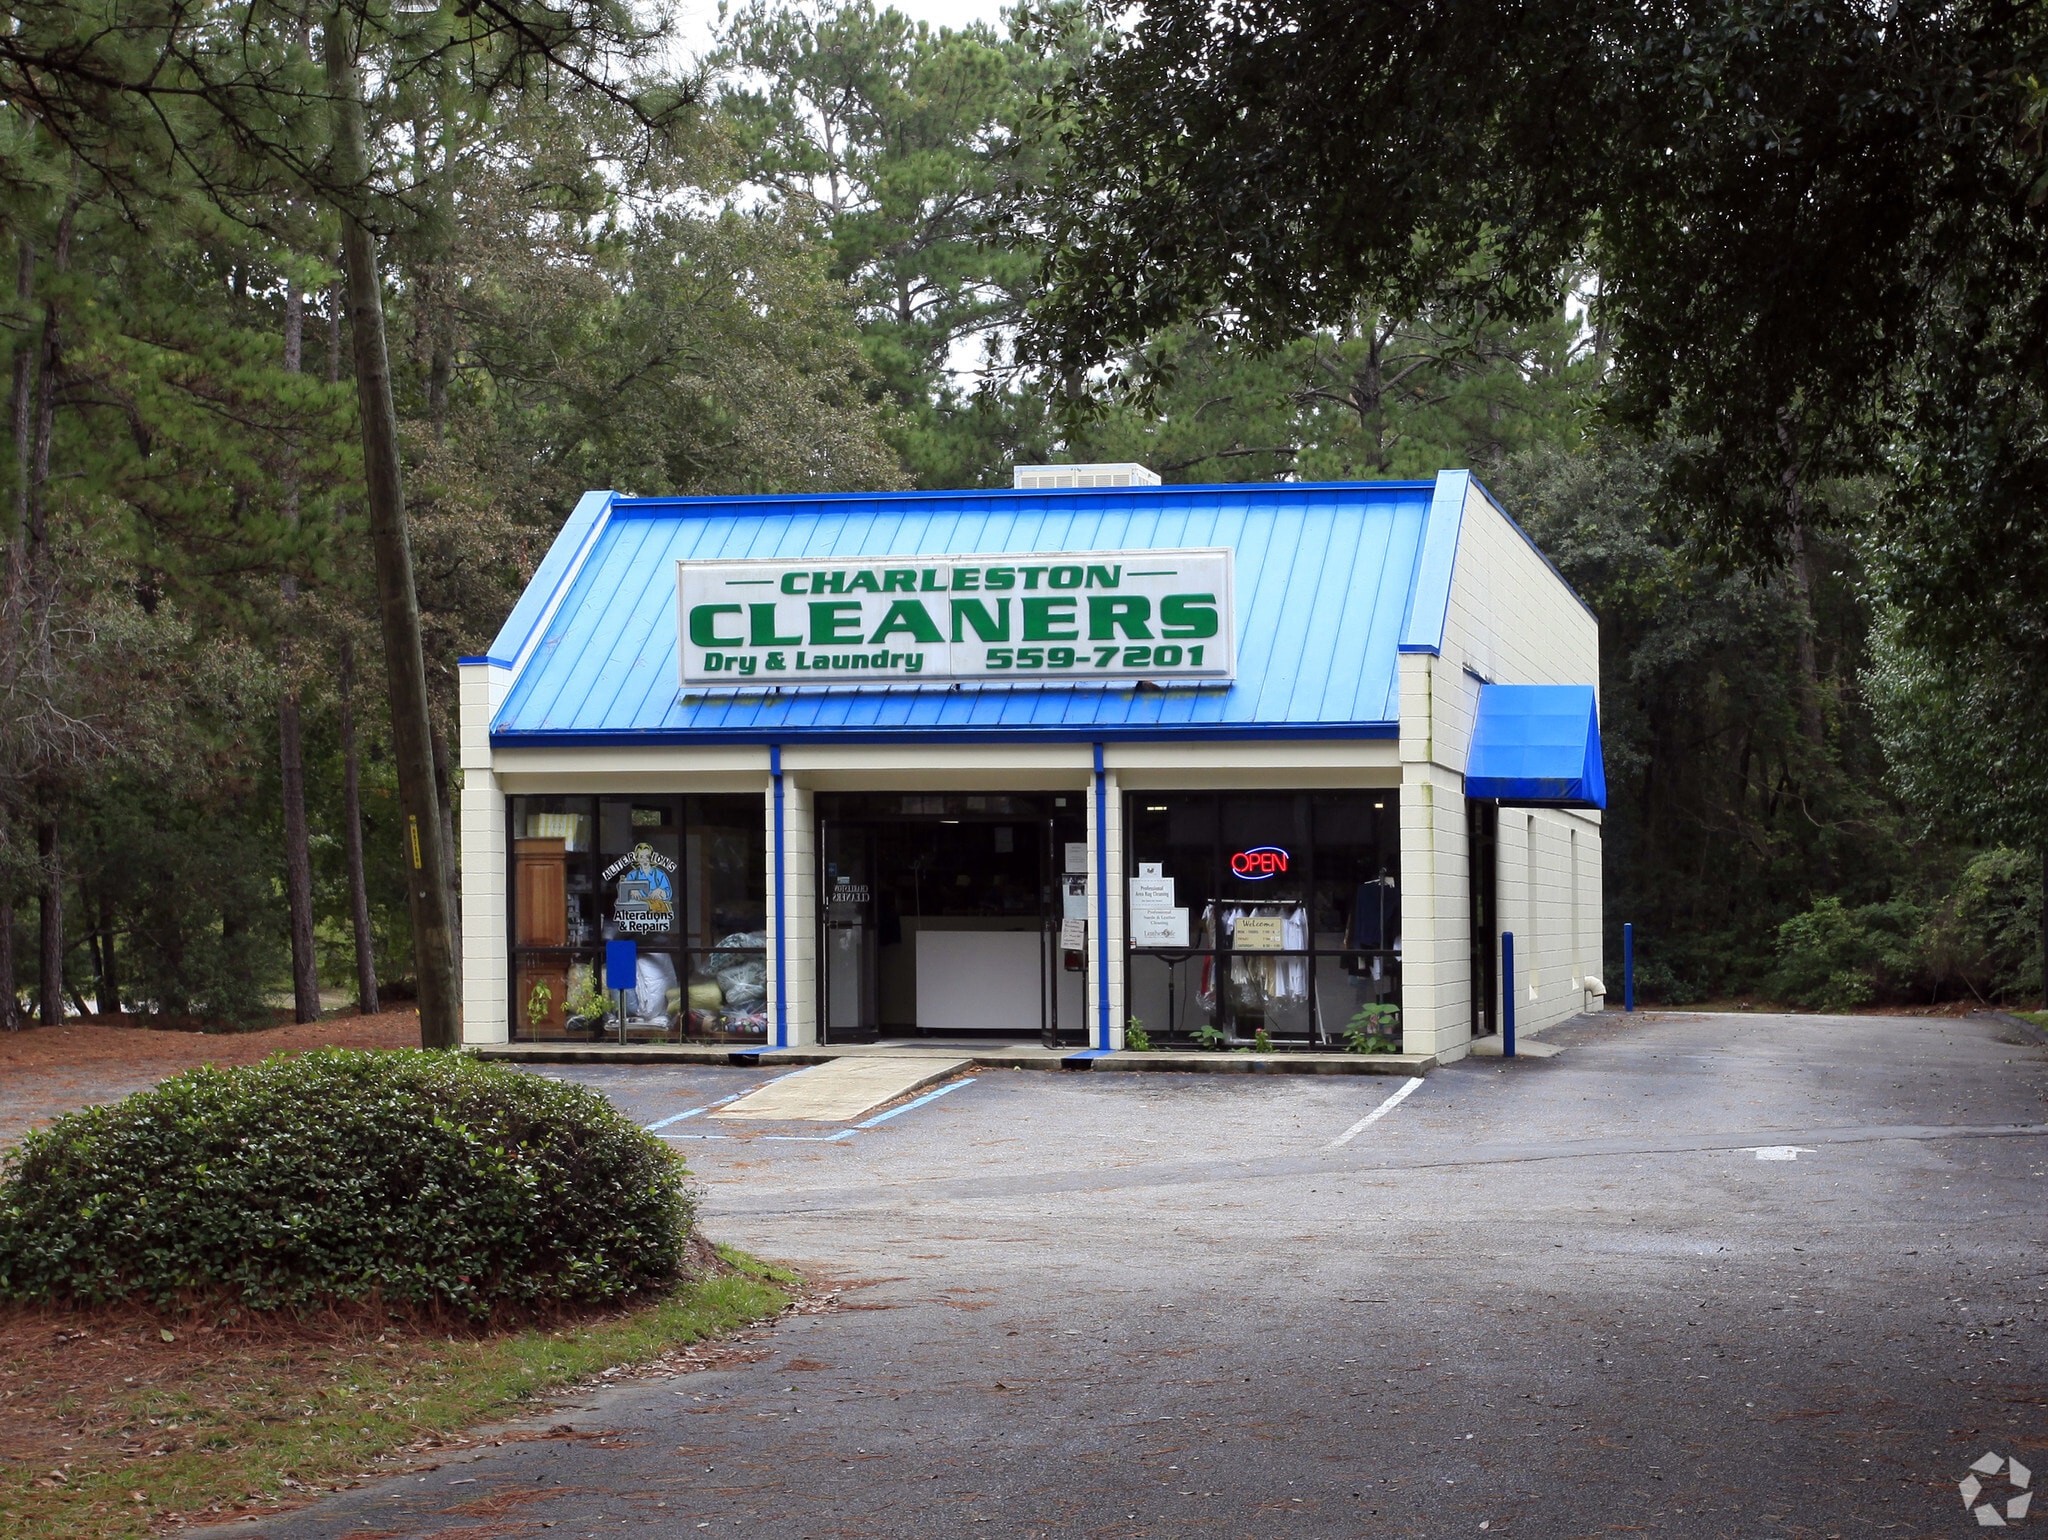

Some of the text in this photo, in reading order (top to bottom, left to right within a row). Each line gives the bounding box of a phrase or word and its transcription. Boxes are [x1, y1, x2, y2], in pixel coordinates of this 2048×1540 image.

[780, 565, 1122, 595] CHARLESTON
[689, 593, 1219, 647] CLEANERS
[703, 649, 924, 675] Dry & Laundry
[985, 645, 1206, 669] 559-7201
[1231, 852, 1287, 872] OPEN
[613, 910, 674, 921] Alterations
[1243, 919, 1275, 927] Welcome
[619, 921, 669, 934] & Repairs
